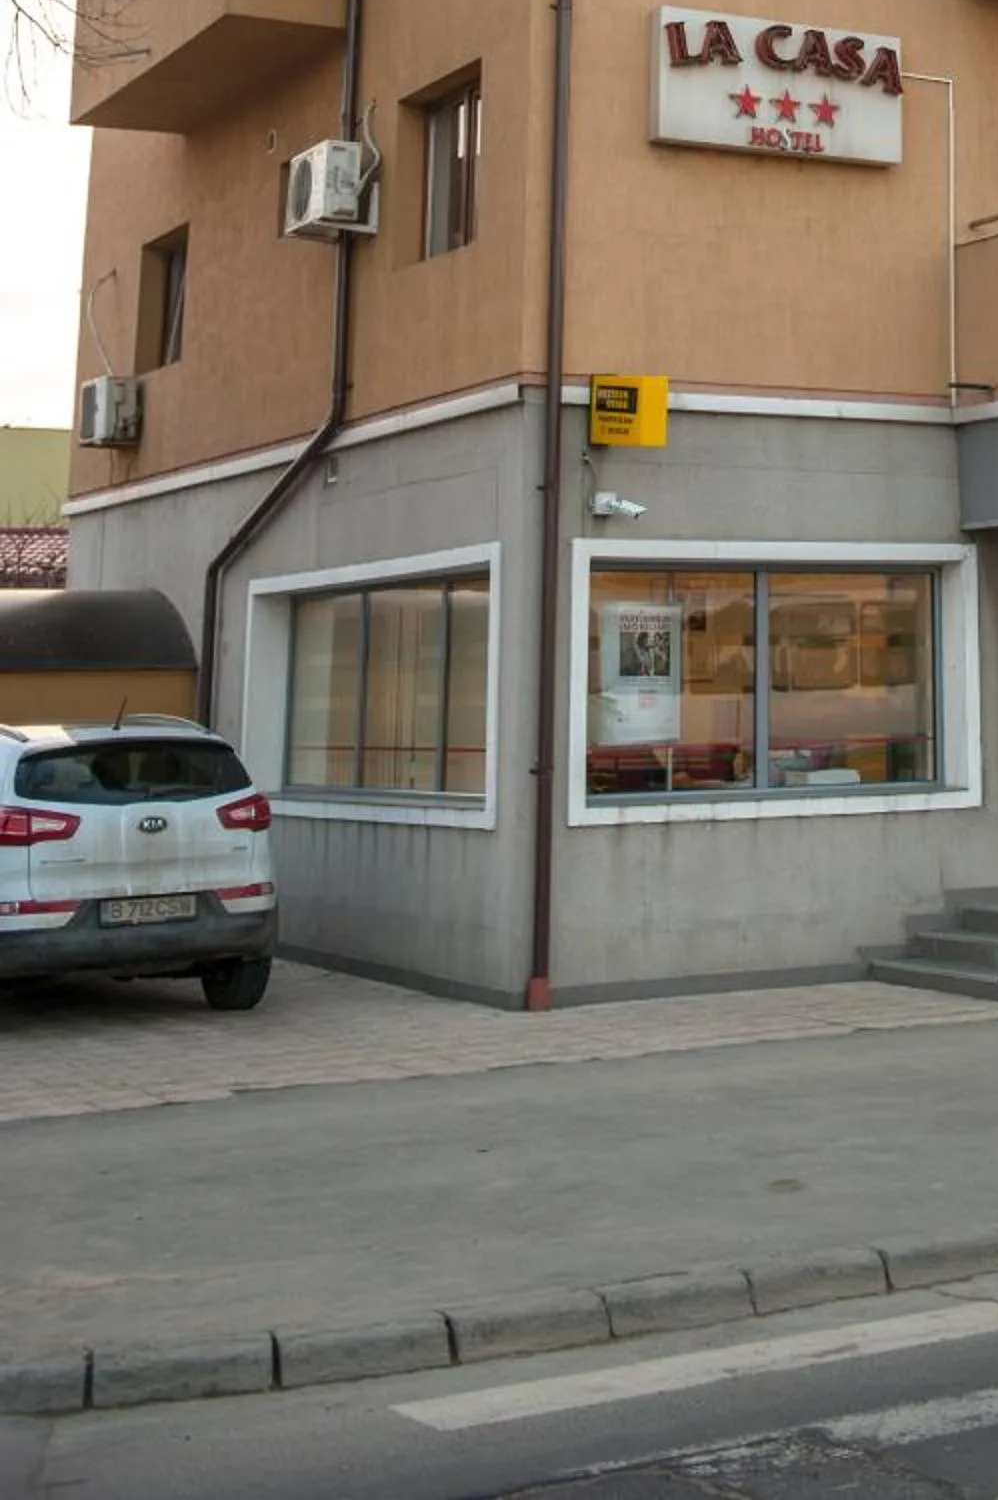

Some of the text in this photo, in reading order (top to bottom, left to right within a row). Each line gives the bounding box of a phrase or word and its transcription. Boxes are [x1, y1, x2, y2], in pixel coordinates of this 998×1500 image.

[664, 20, 903, 96] LA CASA
[143, 819, 164, 829] KIA
